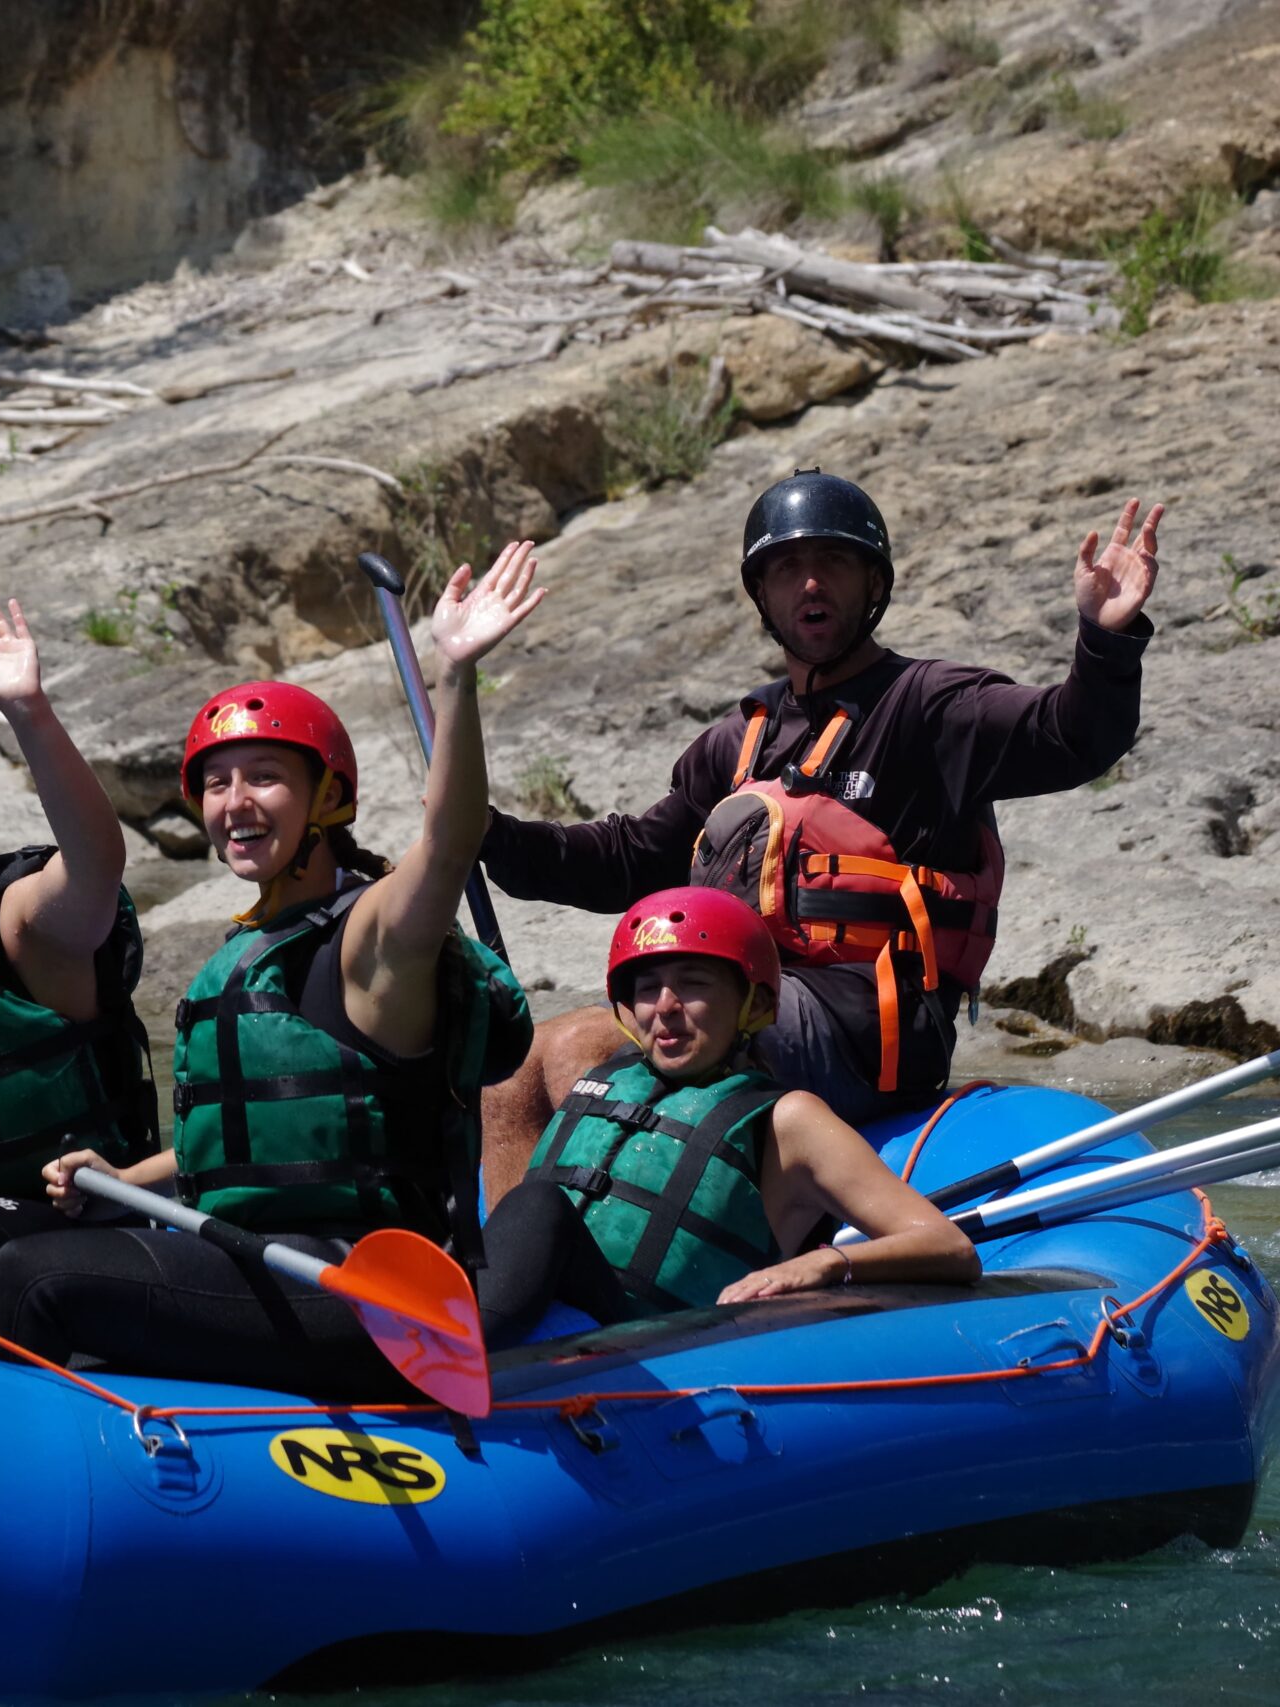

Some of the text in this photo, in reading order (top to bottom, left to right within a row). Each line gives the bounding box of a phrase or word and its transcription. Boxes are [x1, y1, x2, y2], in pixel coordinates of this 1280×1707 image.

[840, 771, 859, 781] THE
[837, 790, 857, 800] ACE
[632, 916, 677, 951] Palm
[1195, 1274, 1242, 1333] NRS
[280, 1439, 436, 1489] NRS
